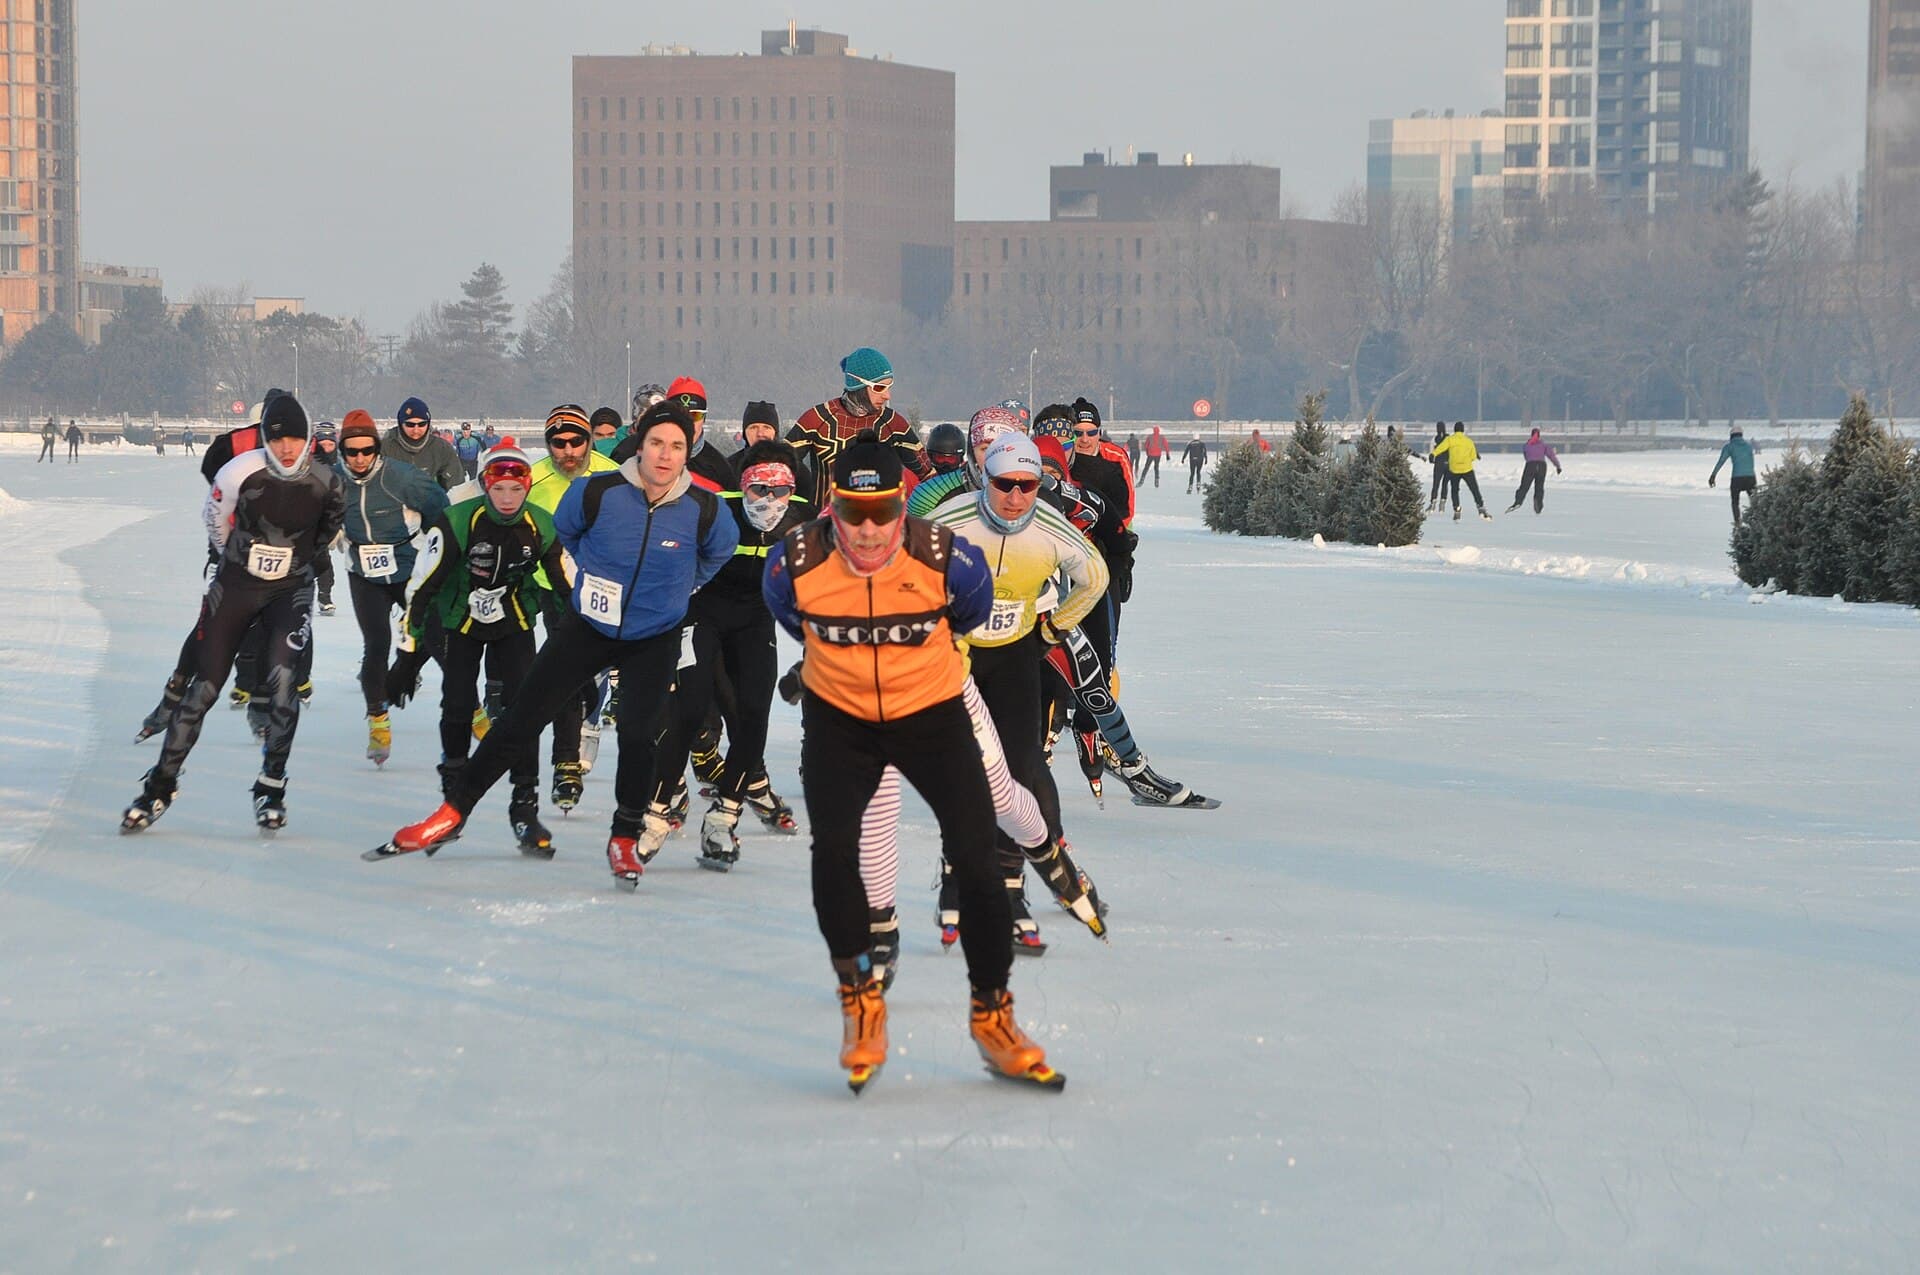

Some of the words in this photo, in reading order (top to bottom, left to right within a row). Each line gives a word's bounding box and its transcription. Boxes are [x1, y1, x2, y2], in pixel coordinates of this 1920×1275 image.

[256, 556, 284, 573] 137
[366, 555, 389, 570] 128
[475, 597, 497, 616] 162
[590, 591, 609, 613] 68
